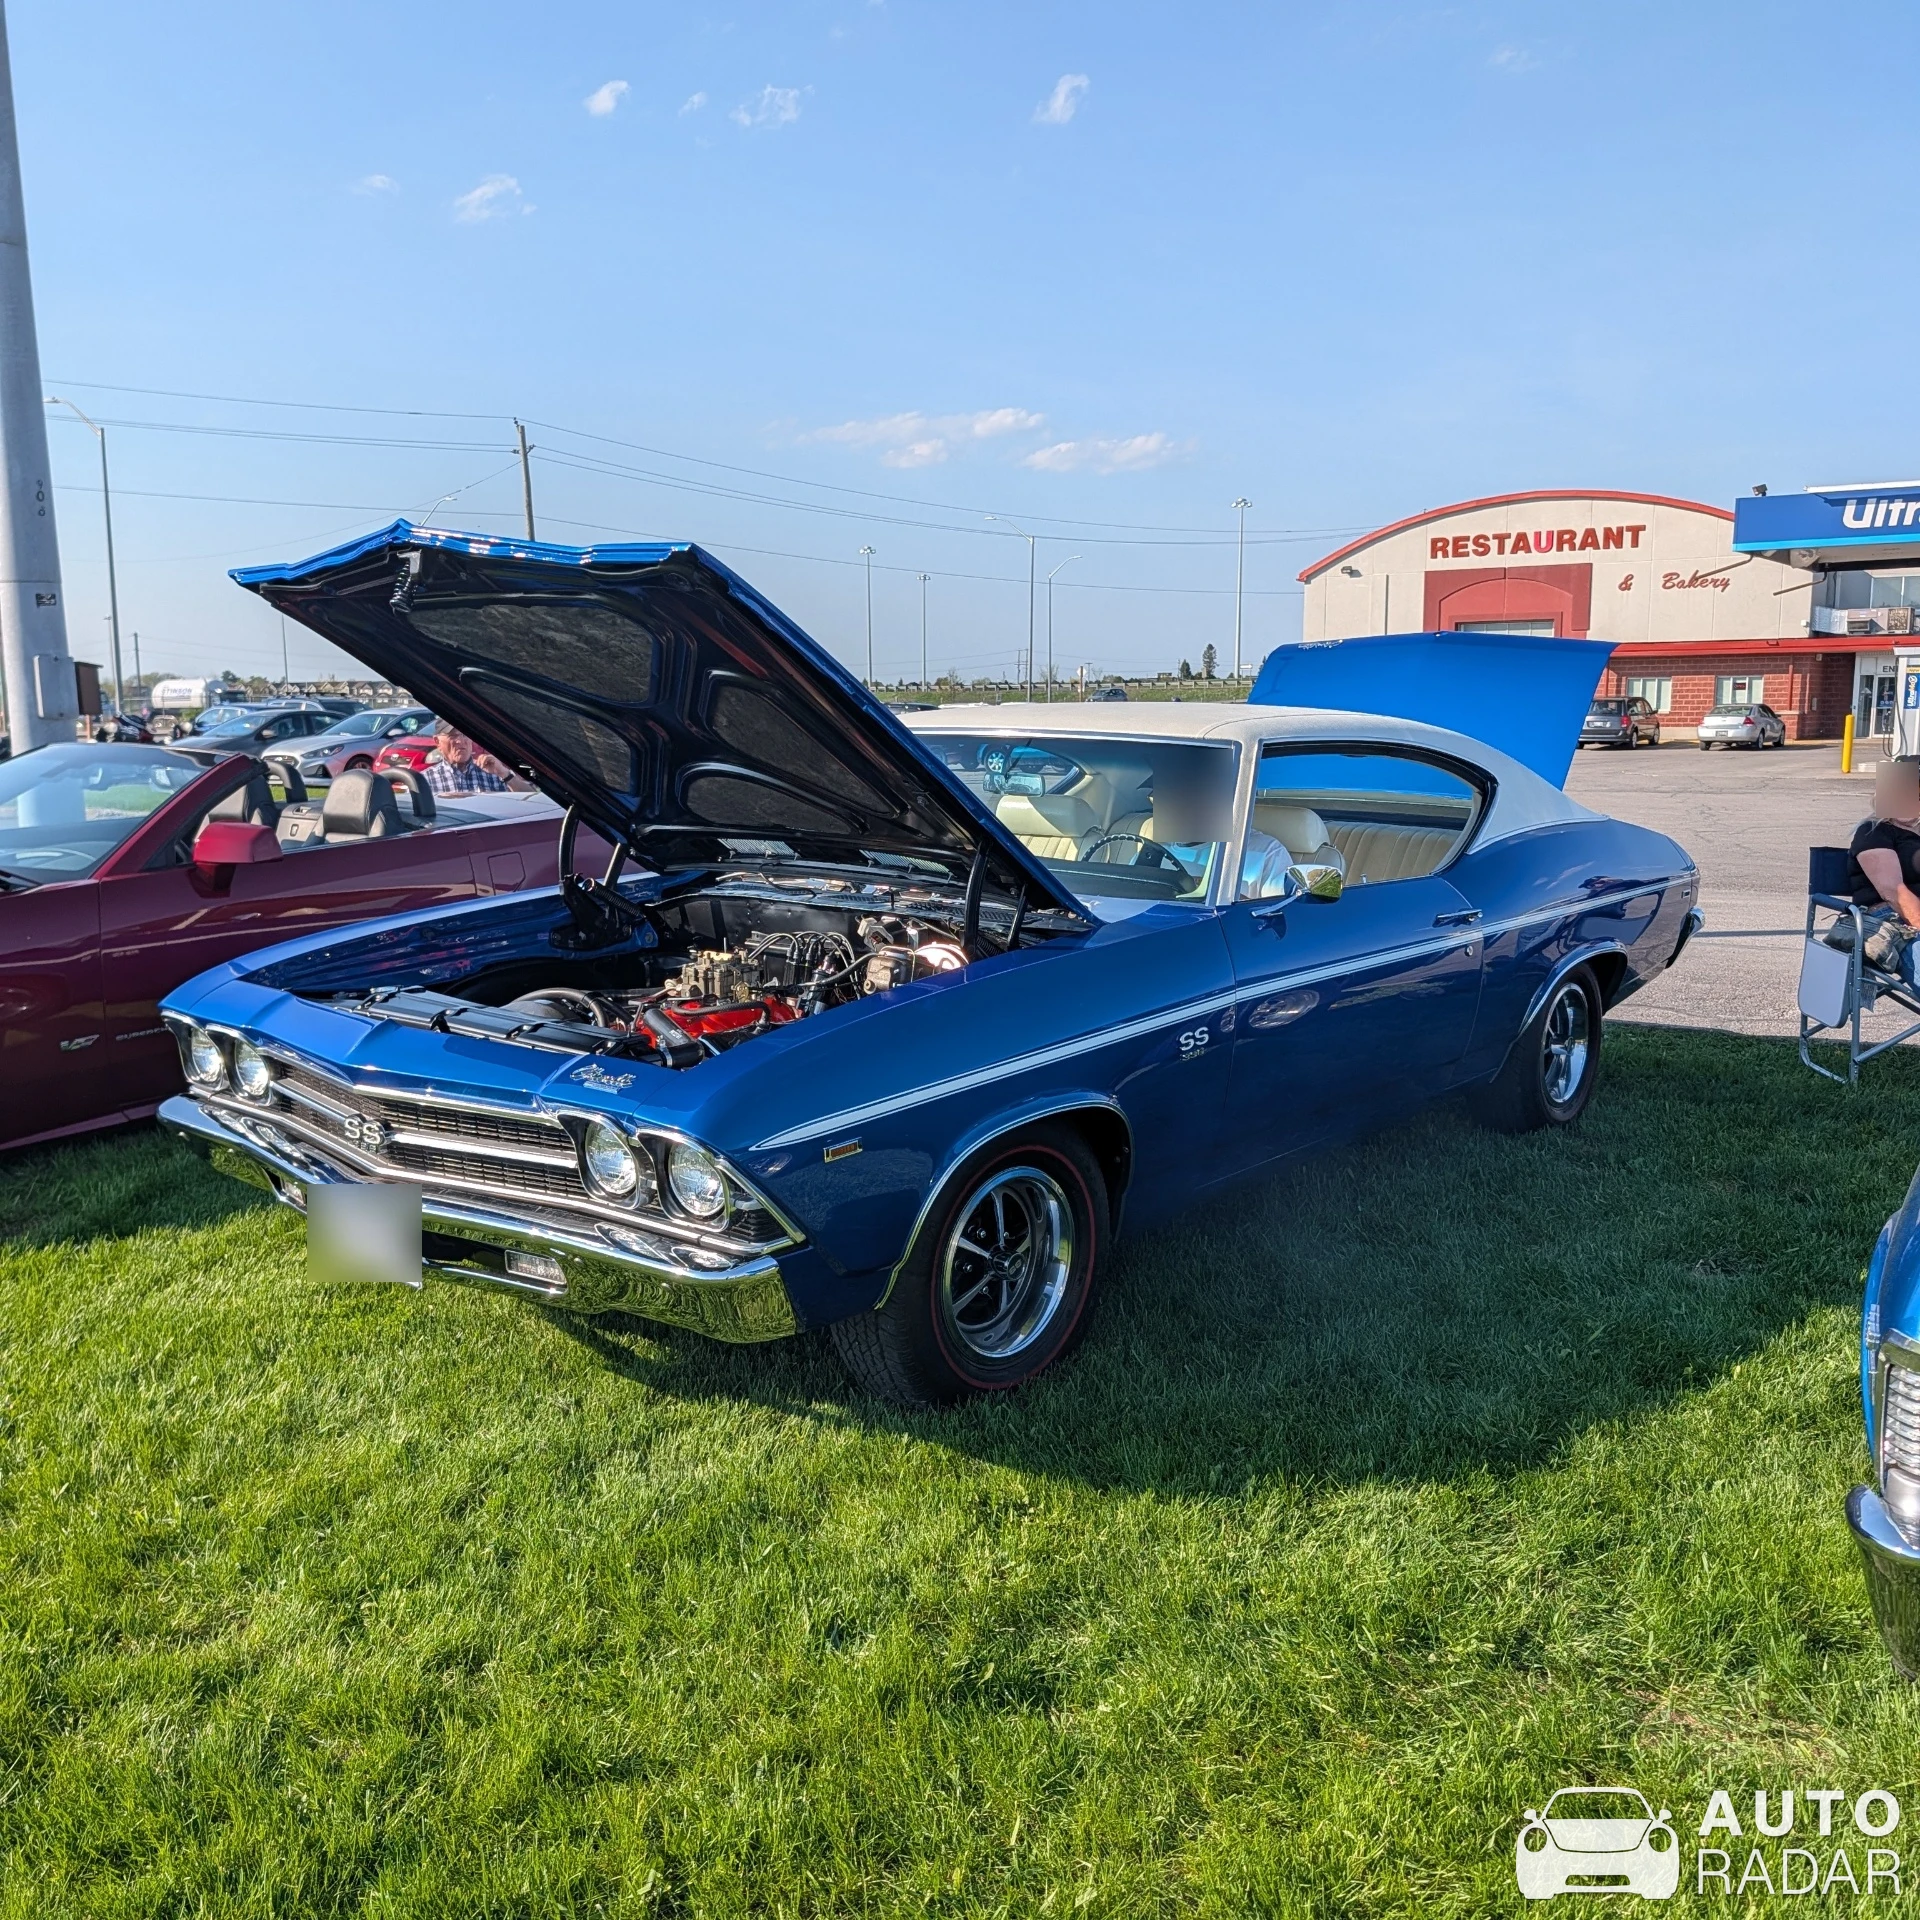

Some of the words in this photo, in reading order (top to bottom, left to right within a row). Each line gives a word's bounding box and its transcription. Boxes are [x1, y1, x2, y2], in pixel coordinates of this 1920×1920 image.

[1842, 498, 1920, 529] Ultr
[1430, 525, 1646, 559] RESTAURANT
[1618, 573, 1634, 592] &
[1662, 569, 1731, 592] Bakery
[1179, 1026, 1210, 1051] SS
[344, 1118, 381, 1145] SS
